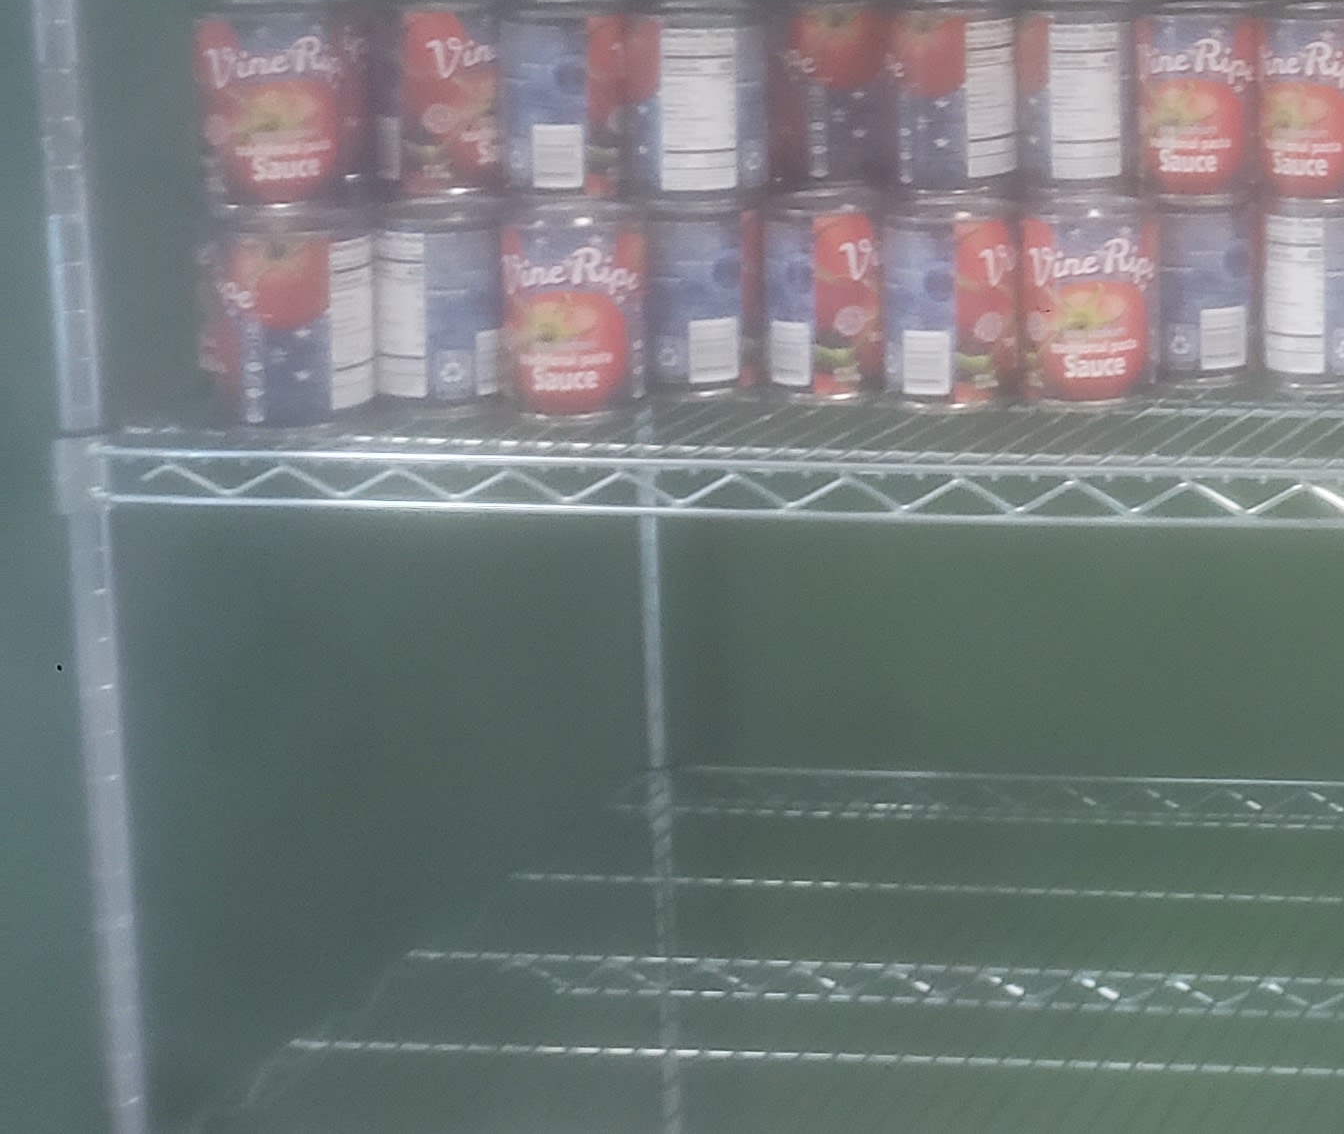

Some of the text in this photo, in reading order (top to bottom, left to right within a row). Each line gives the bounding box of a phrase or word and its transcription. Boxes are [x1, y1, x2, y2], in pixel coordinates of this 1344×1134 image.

[204, 46, 290, 89] Vine
[425, 36, 498, 79] Vin
[1159, 148, 1218, 172] Sauce
[1272, 152, 1329, 176] Sauce
[1029, 247, 1099, 286] Vine
[533, 366, 600, 392] Sauce
[1063, 354, 1127, 379] Sauce
